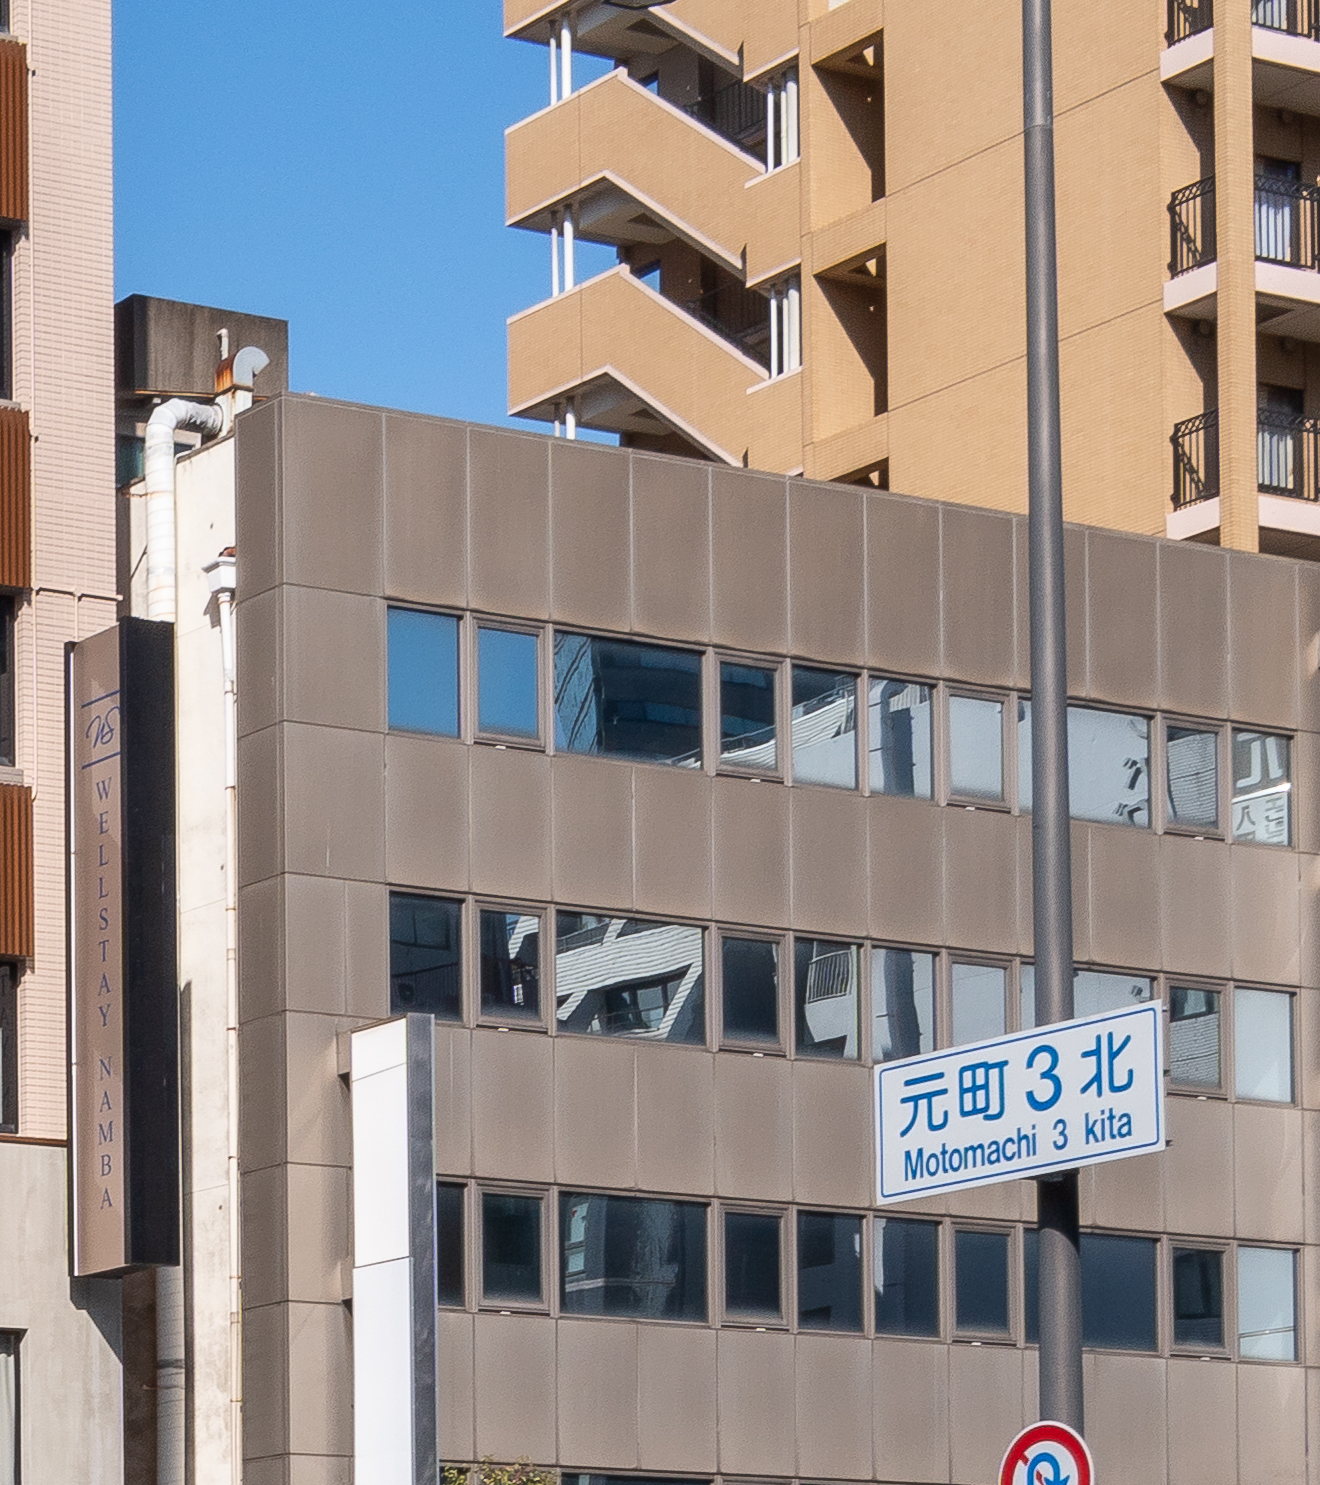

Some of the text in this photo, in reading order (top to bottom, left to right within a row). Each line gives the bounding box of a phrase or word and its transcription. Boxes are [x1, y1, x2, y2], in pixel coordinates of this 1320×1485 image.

[95, 776, 115, 1211] WELLSTAY NAMBA
[899, 1031, 1135, 1137] 元町3北
[904, 1109, 1133, 1183] Motomachi 3 kita
